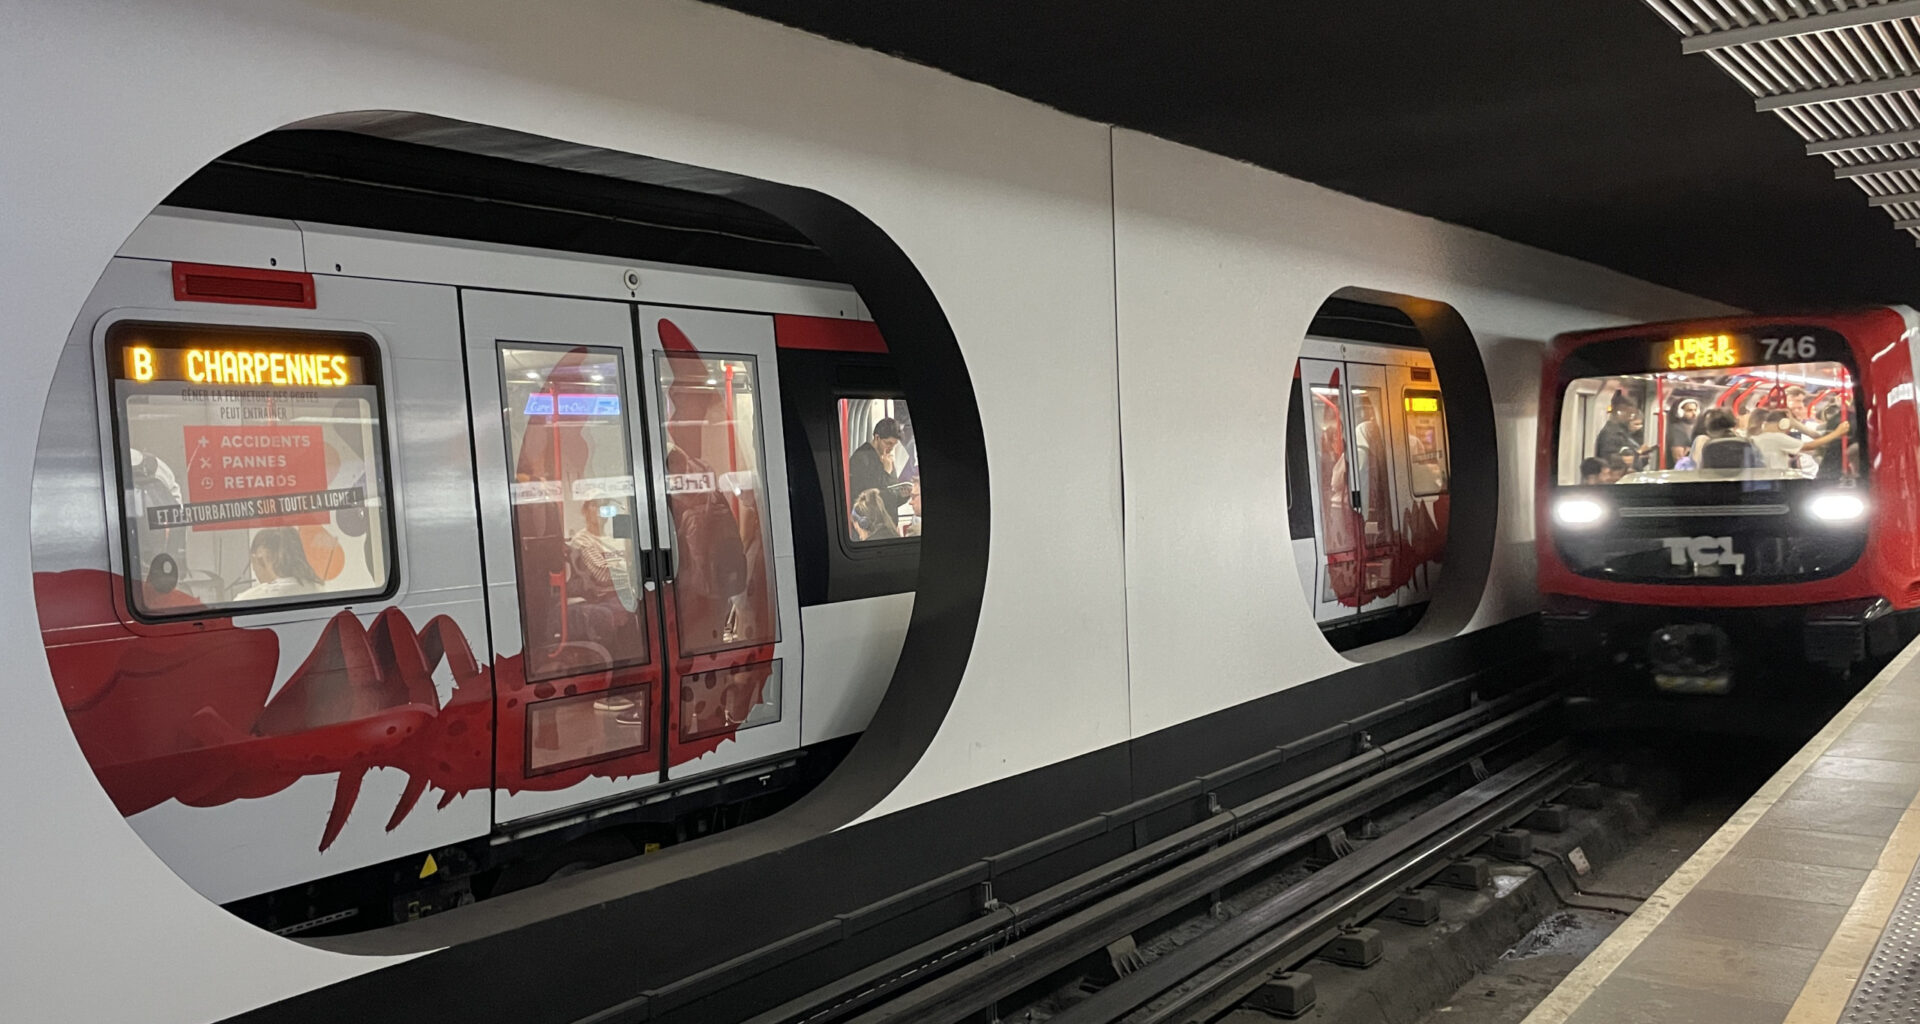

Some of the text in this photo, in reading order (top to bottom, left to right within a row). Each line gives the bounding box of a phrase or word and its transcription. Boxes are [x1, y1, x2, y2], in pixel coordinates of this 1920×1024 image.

[1761, 336, 1816, 360] 746
[133, 347, 348, 385] B CHARPENNES
[212, 390, 223, 402] LA
[273, 391, 288, 402] DES
[220, 407, 240, 420] PEUT
[220, 435, 311, 448] ACCIDENTS
[222, 456, 287, 469] PANNES
[224, 475, 297, 489] RETARDS
[156, 509, 169, 525] ET
[172, 502, 255, 523] PERTURBATIONS
[257, 499, 276, 515] SUR
[280, 496, 308, 512] TOUTE
[311, 495, 323, 509] LA
[324, 492, 350, 507] LIGNE
[1662, 535, 1745, 567] TCL
